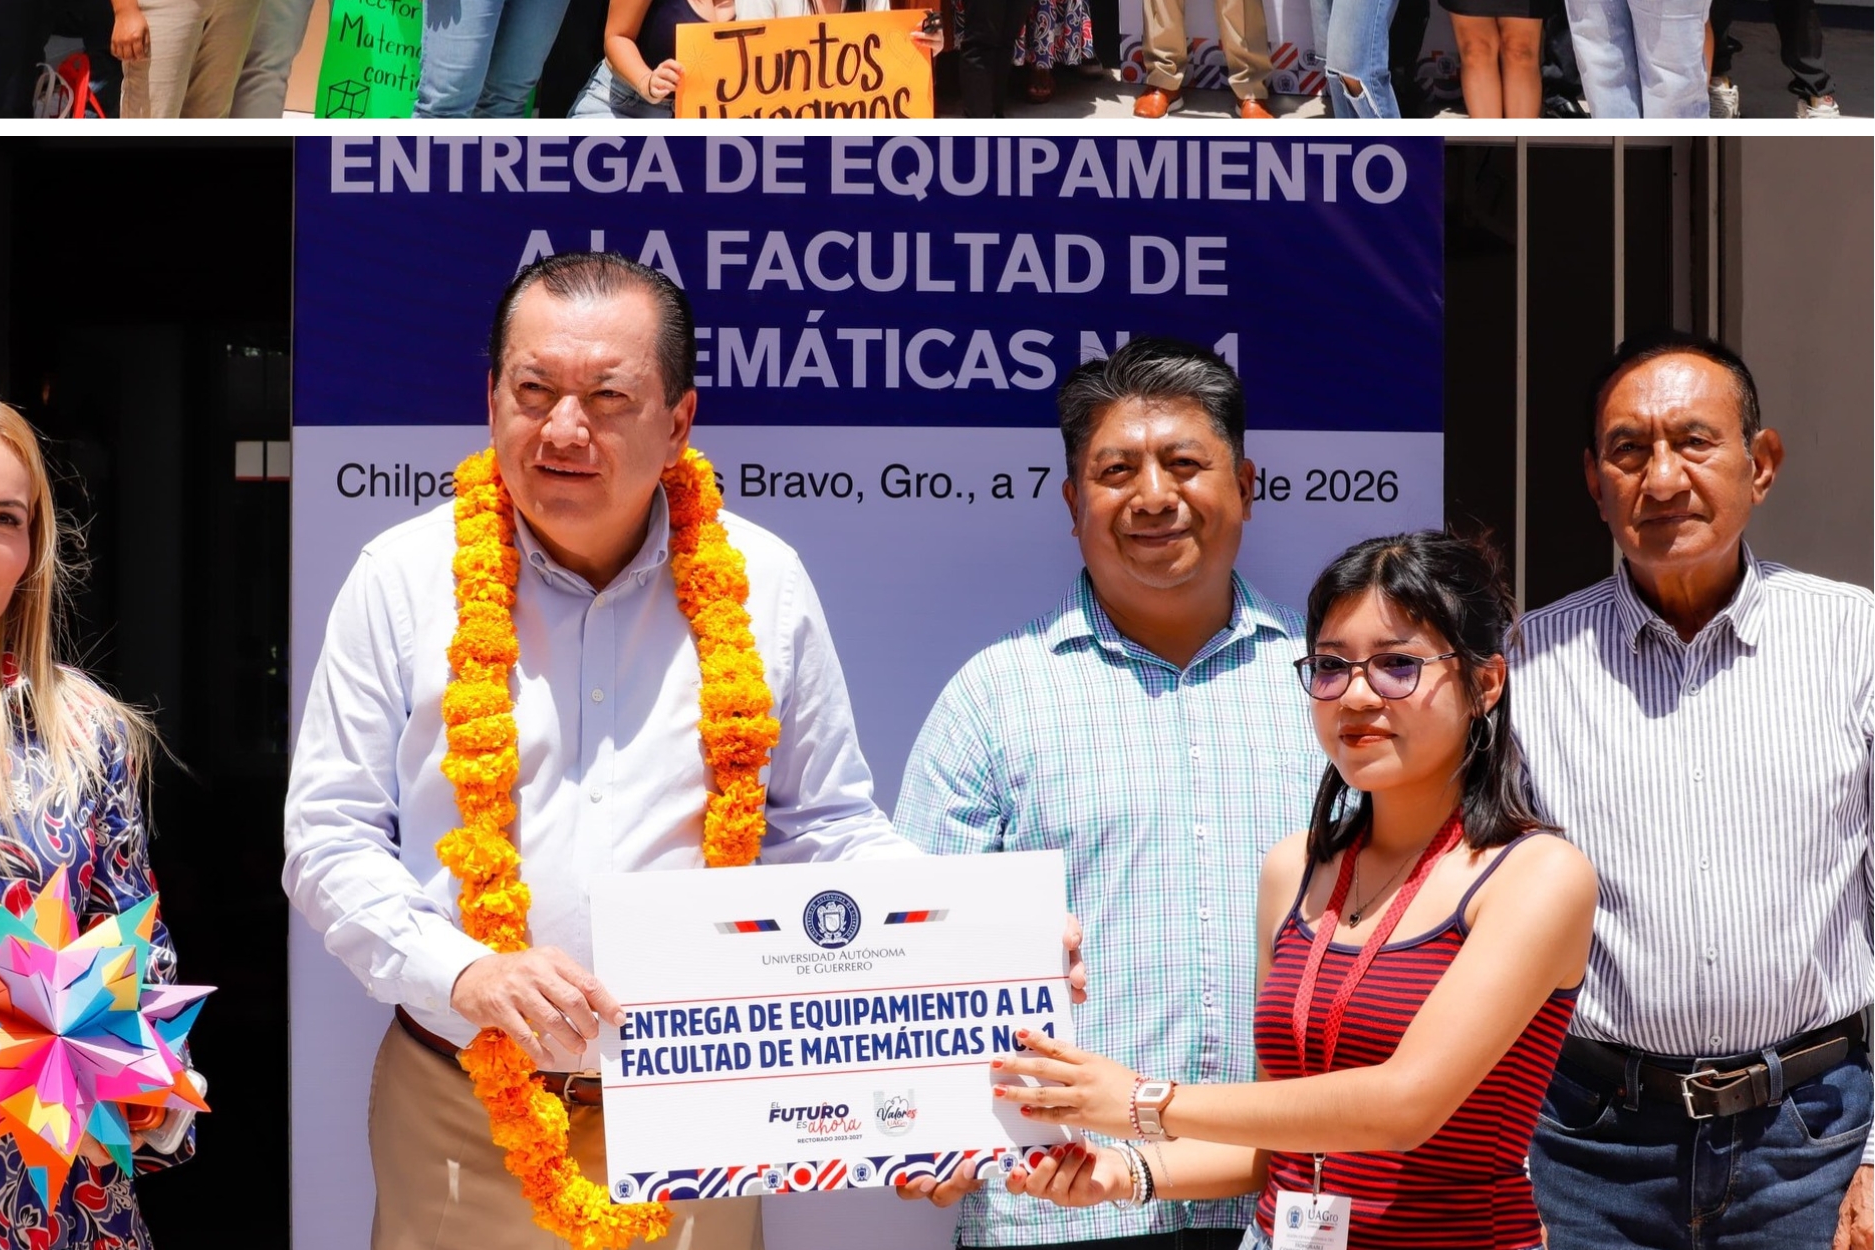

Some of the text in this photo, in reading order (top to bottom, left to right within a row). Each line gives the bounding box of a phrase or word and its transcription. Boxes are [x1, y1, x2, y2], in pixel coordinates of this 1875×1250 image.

[713, 21, 884, 102] Juntos
[363, 64, 420, 94] conti
[330, 136, 1408, 205] ENTREGA DE EQUIPAMIENTO
[706, 230, 1105, 294] FACULTAD
[1129, 236, 1229, 296] DE
[694, 310, 1057, 391] EMÁTICAS
[336, 462, 458, 506] Chilpa
[740, 462, 864, 505] Bravo,
[880, 462, 976, 505] Gro.,
[991, 472, 1014, 499] a
[1027, 466, 1051, 499] 7
[1253, 468, 1291, 502] de
[1305, 469, 1399, 503] 2026
[762, 947, 906, 966] UNIVERSIDAD AUTÓNOMA
[796, 961, 873, 975] DE GUERRERO
[619, 985, 1055, 1041] ENTREGA DE EQUIPAMIENTO A LA
[621, 1042, 752, 1077] FACULTAD
[759, 1039, 794, 1069] DE
[801, 1026, 986, 1066] MATEMÁTICAS
[768, 1104, 850, 1123] FUTURO
[796, 1109, 862, 1135] ES ahora
[876, 1105, 917, 1122] Valores
[797, 1136, 833, 1144] RECTORADO
[1307, 1208, 1339, 1223] UAGro
